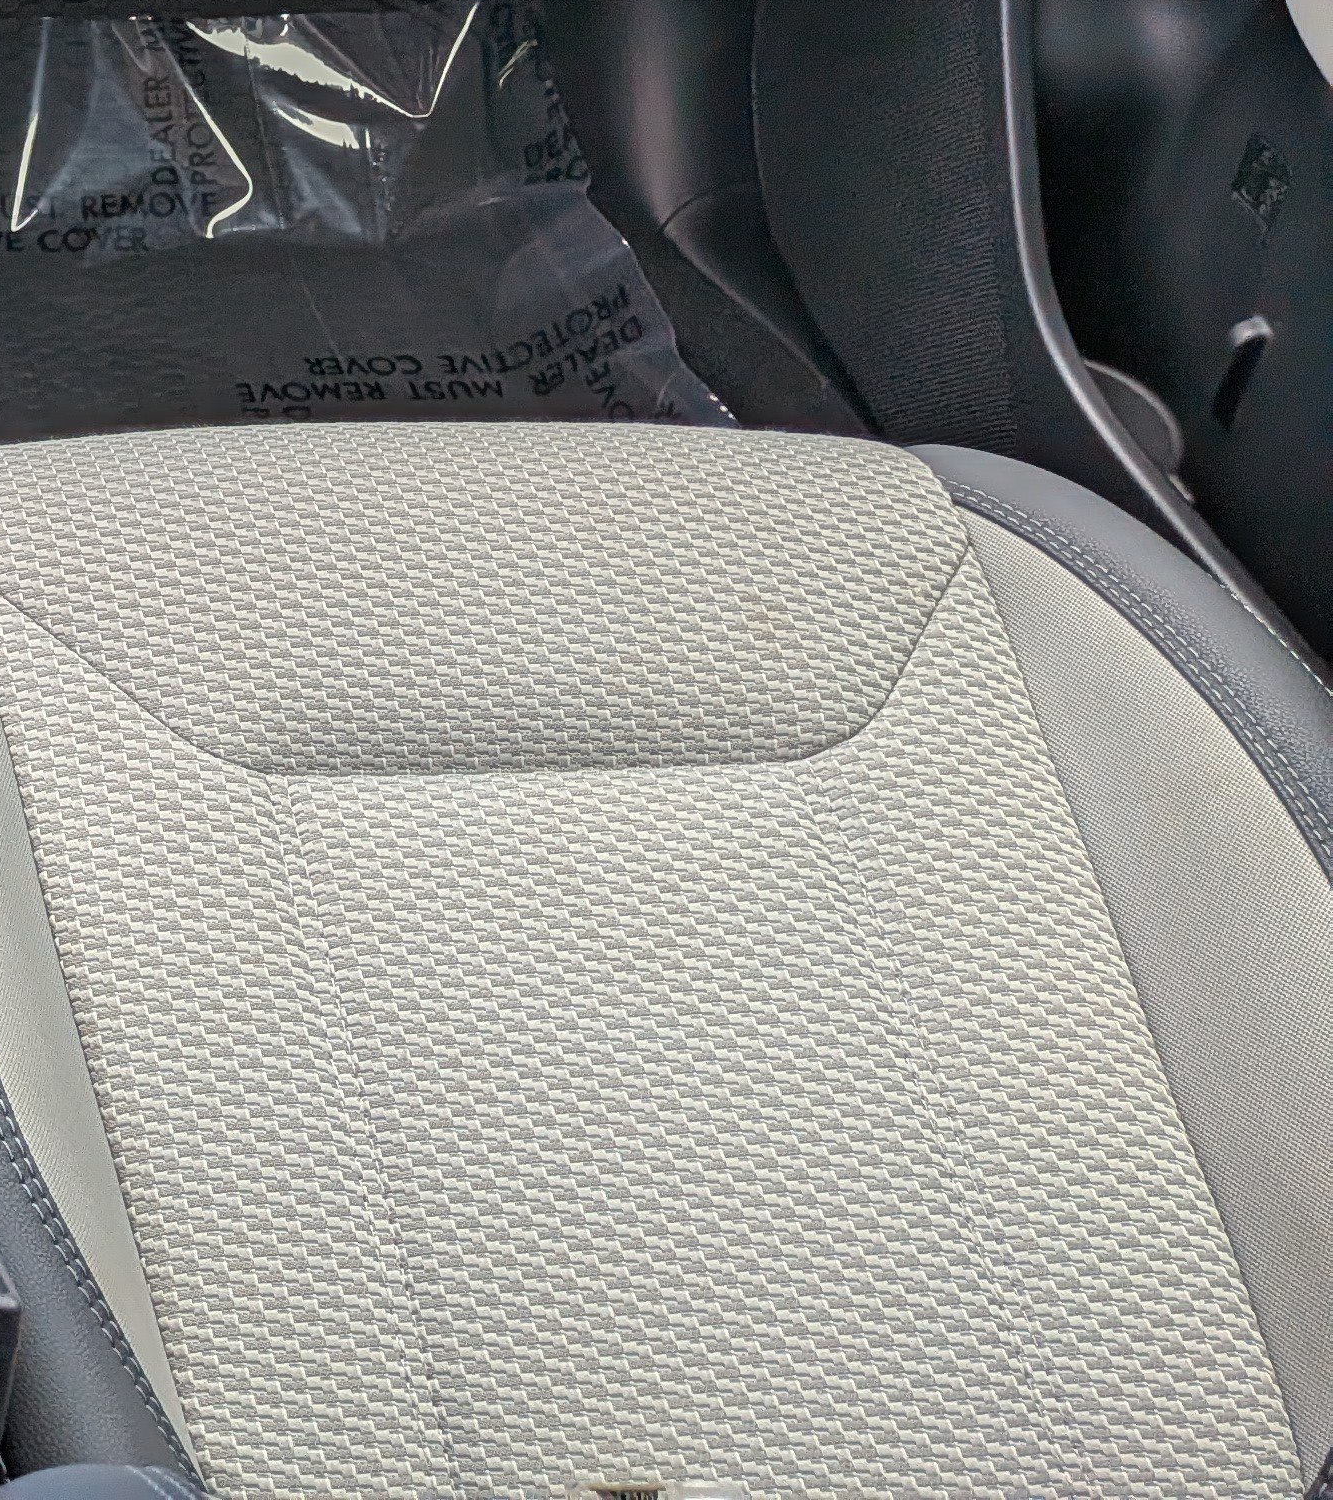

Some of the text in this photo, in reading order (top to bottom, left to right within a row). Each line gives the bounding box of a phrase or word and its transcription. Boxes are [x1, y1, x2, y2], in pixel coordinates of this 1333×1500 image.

[144, 75, 180, 187] DEALER
[36, 227, 149, 254] COVER
[233, 314, 644, 405] DEALER MUST REMOVE
[303, 284, 630, 379] PROTECTIVE COVER
